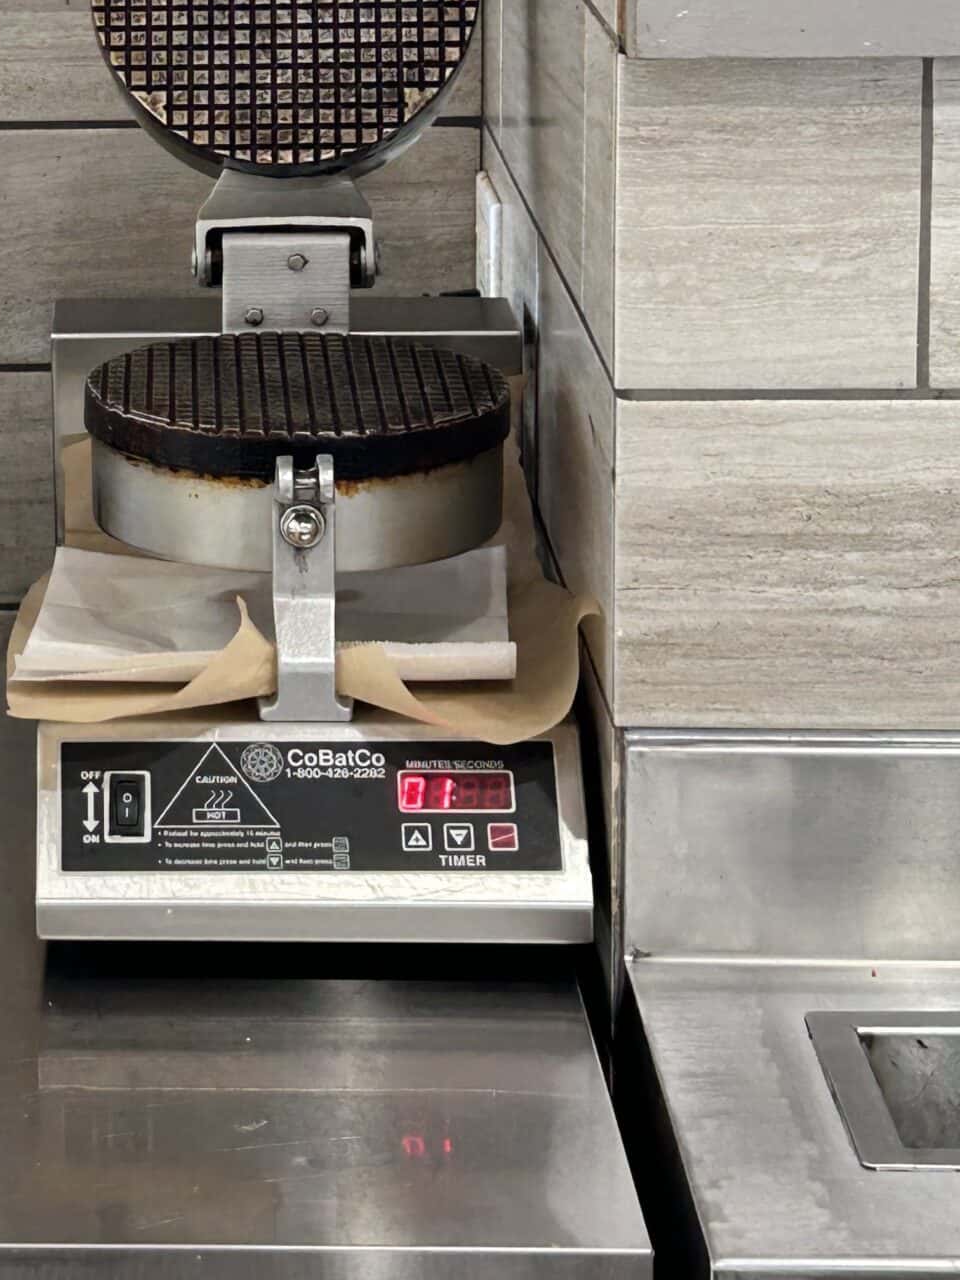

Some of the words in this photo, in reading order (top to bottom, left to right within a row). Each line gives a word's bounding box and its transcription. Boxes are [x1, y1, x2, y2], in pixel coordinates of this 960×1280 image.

[287, 749, 386, 767] CoBatCo
[80, 771, 102, 781] OFF
[195, 775, 238, 785] CAUTION
[206, 811, 227, 820] HOT
[82, 834, 100, 844] ON
[438, 855, 487, 867] TIMER
